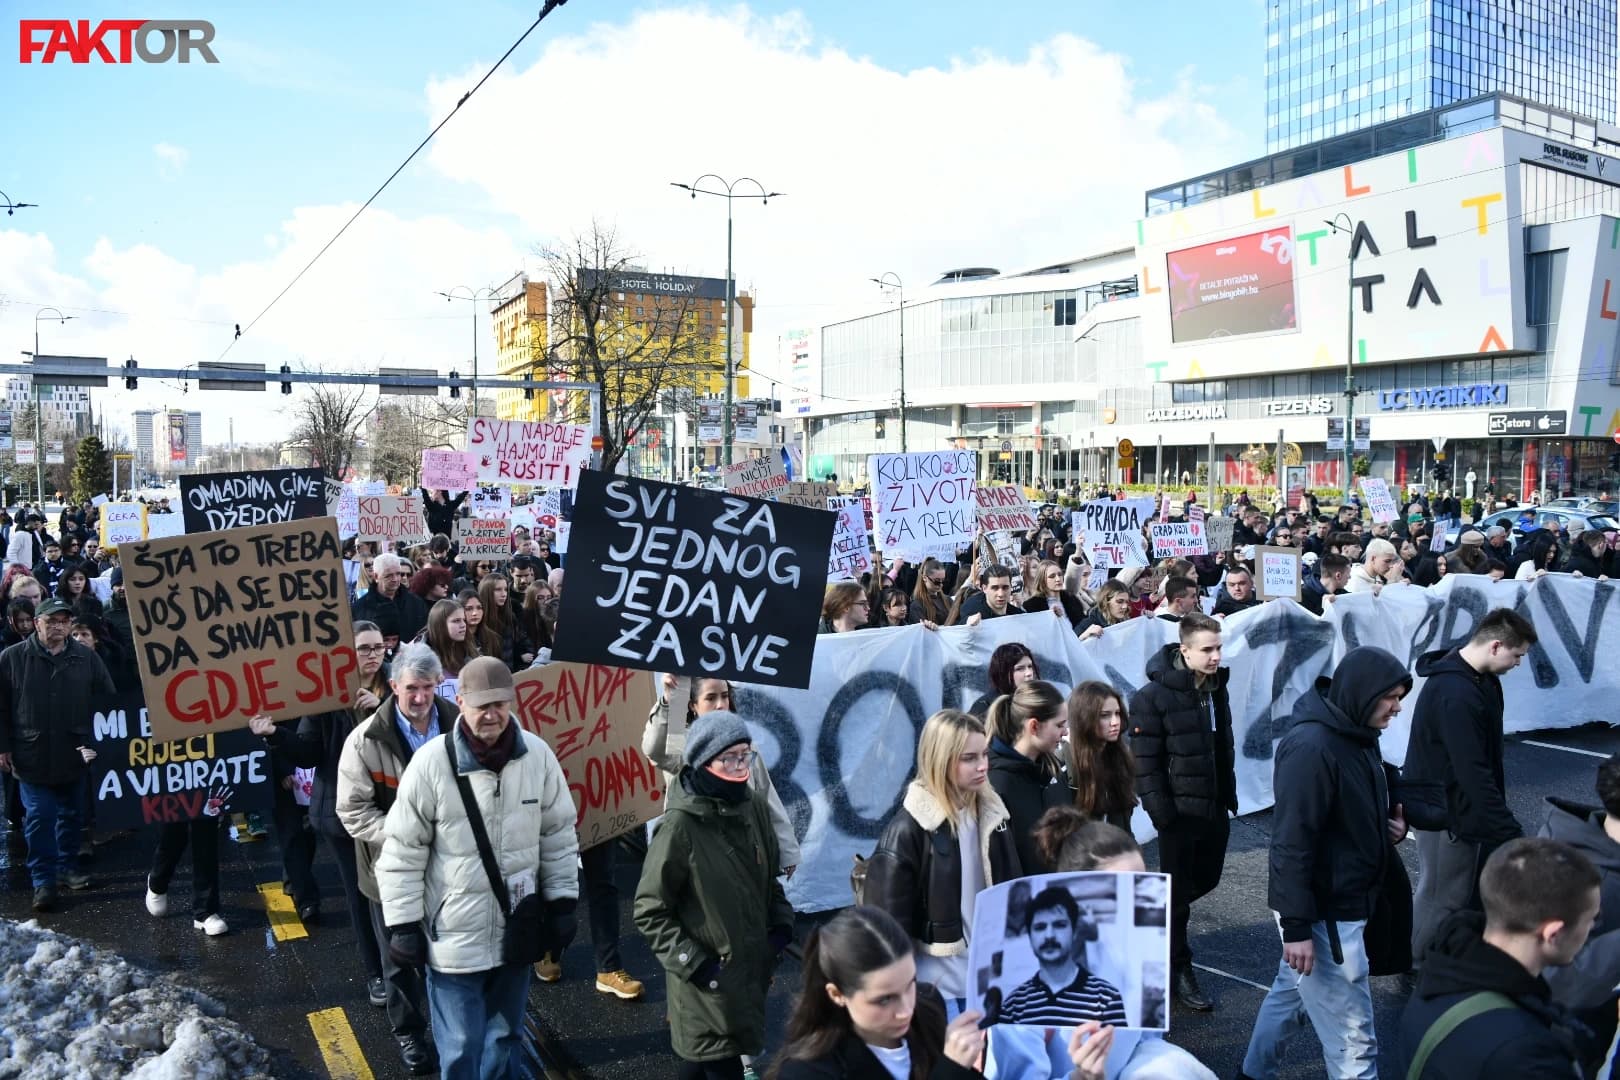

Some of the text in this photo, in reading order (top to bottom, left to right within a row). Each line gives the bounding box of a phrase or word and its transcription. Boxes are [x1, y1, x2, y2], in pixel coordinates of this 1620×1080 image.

[621, 279, 695, 294] HOTEL HOLIDAY
[1145, 404, 1227, 422] CALZEDONIA
[1262, 398, 1333, 416] TEZENIS
[1378, 390, 1408, 411] LC
[471, 419, 511, 446] SVI
[496, 443, 564, 464] HAJMO IH
[498, 457, 570, 486] RUŠIT!
[878, 454, 942, 485] KOLIKO
[358, 497, 417, 515] KO JE
[887, 477, 976, 513] ŽIVOTA
[358, 515, 424, 537] ODGOVORAN
[472, 519, 506, 529] PRAVDA
[604, 480, 676, 523] SVI
[712, 497, 777, 544] ZA
[1086, 504, 1141, 532] PRAVDA
[460, 529, 473, 537] ZA
[884, 516, 915, 545] ZA
[1104, 532, 1120, 545] ZA
[1153, 523, 1188, 537] GRAD KOJI
[132, 530, 340, 588] ŠTA TO TREBA
[460, 545, 508, 555] ZA KRIVCE
[608, 521, 801, 590] JEDNOG
[1156, 548, 1171, 558] NAS
[135, 568, 338, 637] JOŠ DA SE DESI
[595, 563, 768, 625] JEDAN
[144, 602, 341, 677] DA SHVATIŠ
[607, 612, 790, 676] ZA SVE
[164, 658, 286, 725] GDJE
[296, 644, 358, 705] SI?
[514, 664, 636, 735] PRAVDA
[93, 709, 129, 742] MI
[555, 711, 611, 761] ZA
[98, 750, 268, 801] A VI BIRATE
[140, 790, 204, 825] KRV
